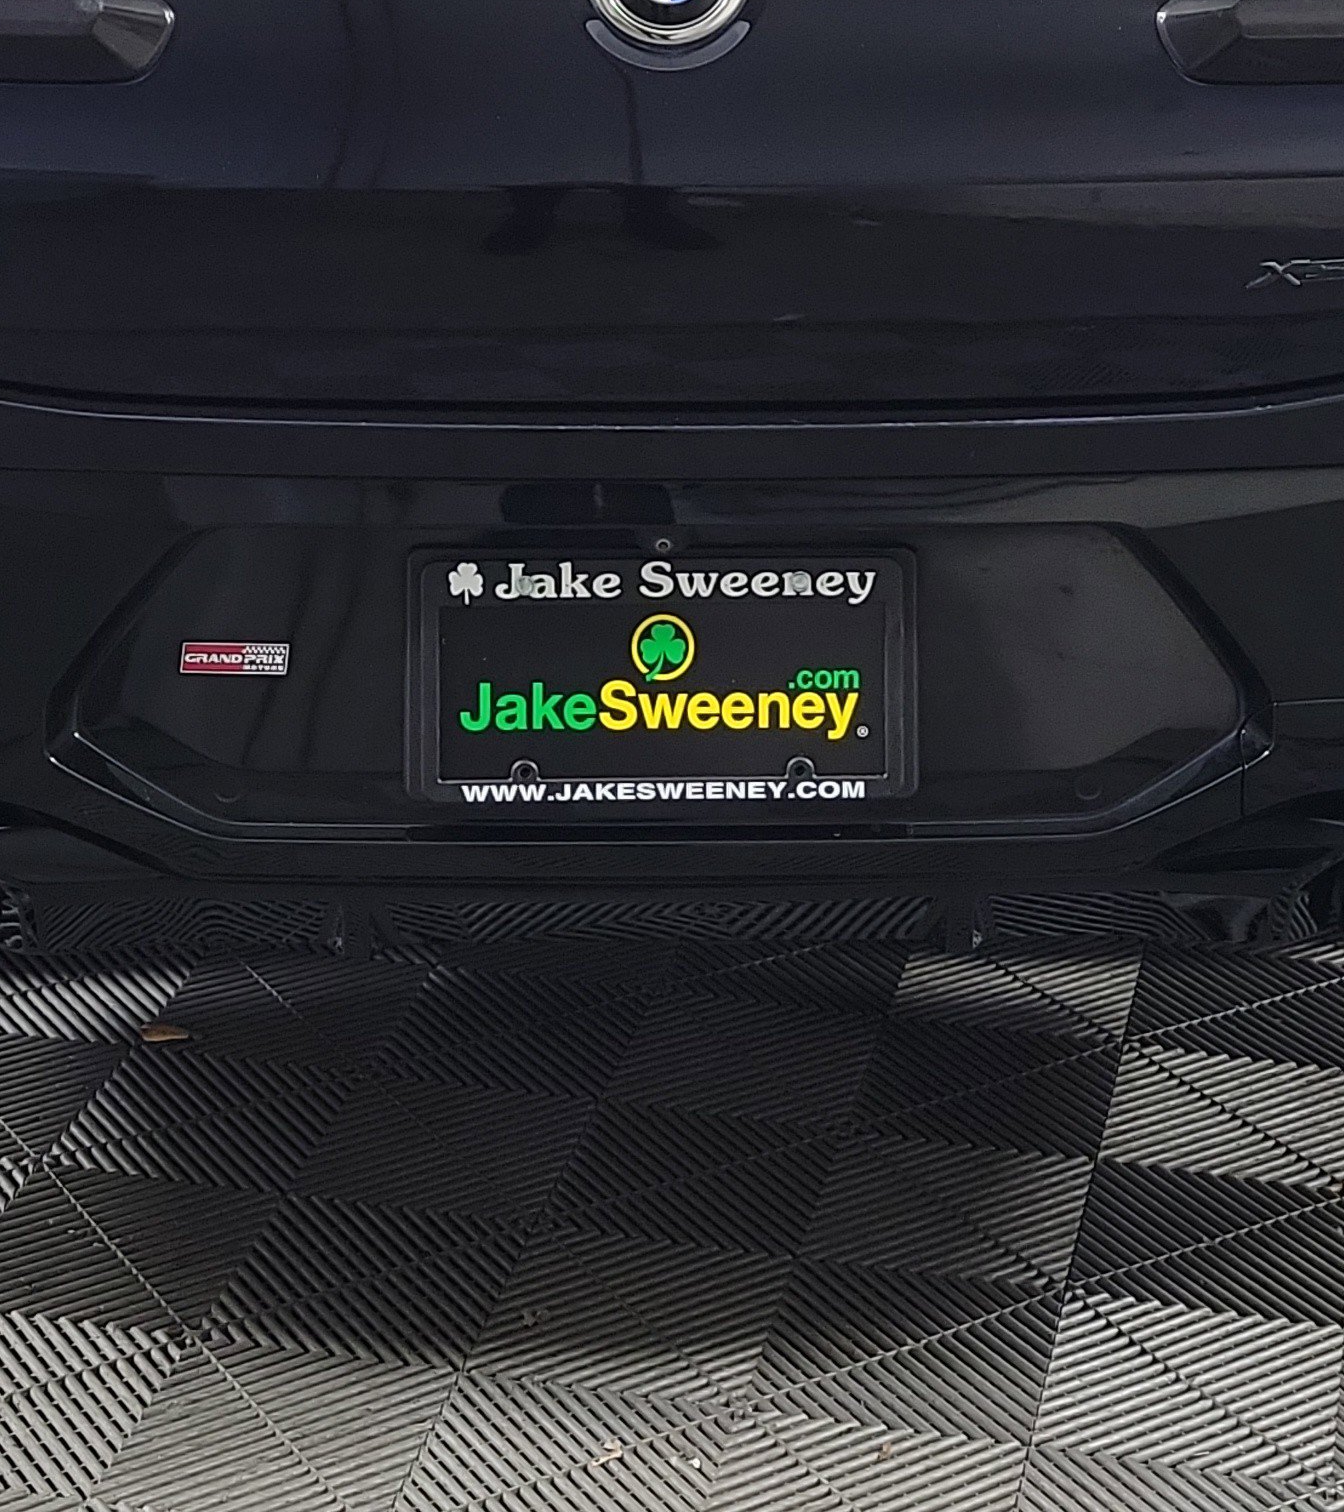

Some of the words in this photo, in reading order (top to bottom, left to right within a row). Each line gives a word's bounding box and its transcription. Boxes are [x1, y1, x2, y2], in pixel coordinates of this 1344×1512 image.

[494, 560, 623, 602] Jake
[638, 560, 876, 605] Sweeney
[184, 652, 243, 665] GRAND
[243, 653, 285, 665] PRIX
[461, 779, 866, 804] WWW.JAKESWEENEY.COM
